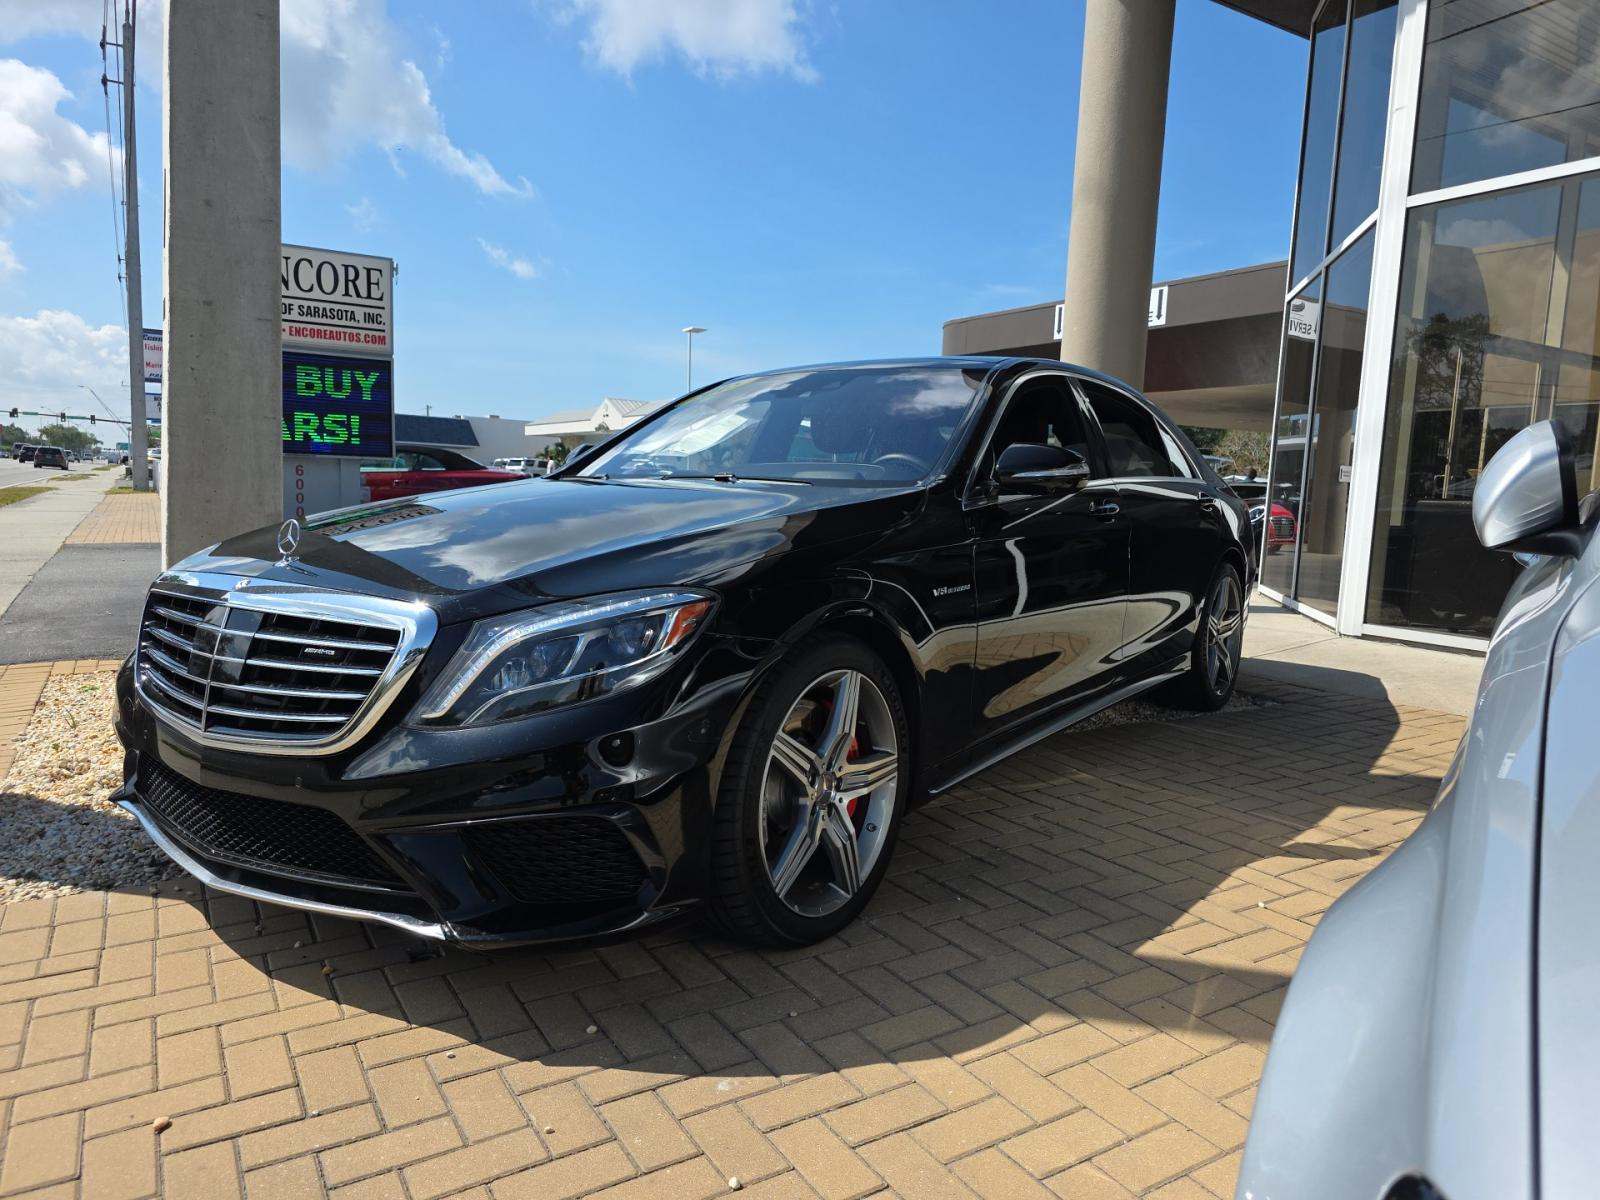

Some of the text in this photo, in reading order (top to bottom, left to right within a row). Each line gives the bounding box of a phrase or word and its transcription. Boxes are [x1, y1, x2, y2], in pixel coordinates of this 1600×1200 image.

[298, 304, 360, 323] SARASOTA,
[364, 312, 386, 326] INC.
[289, 326, 386, 345] ENCOREAUTOS.COM
[296, 366, 380, 400] BUY
